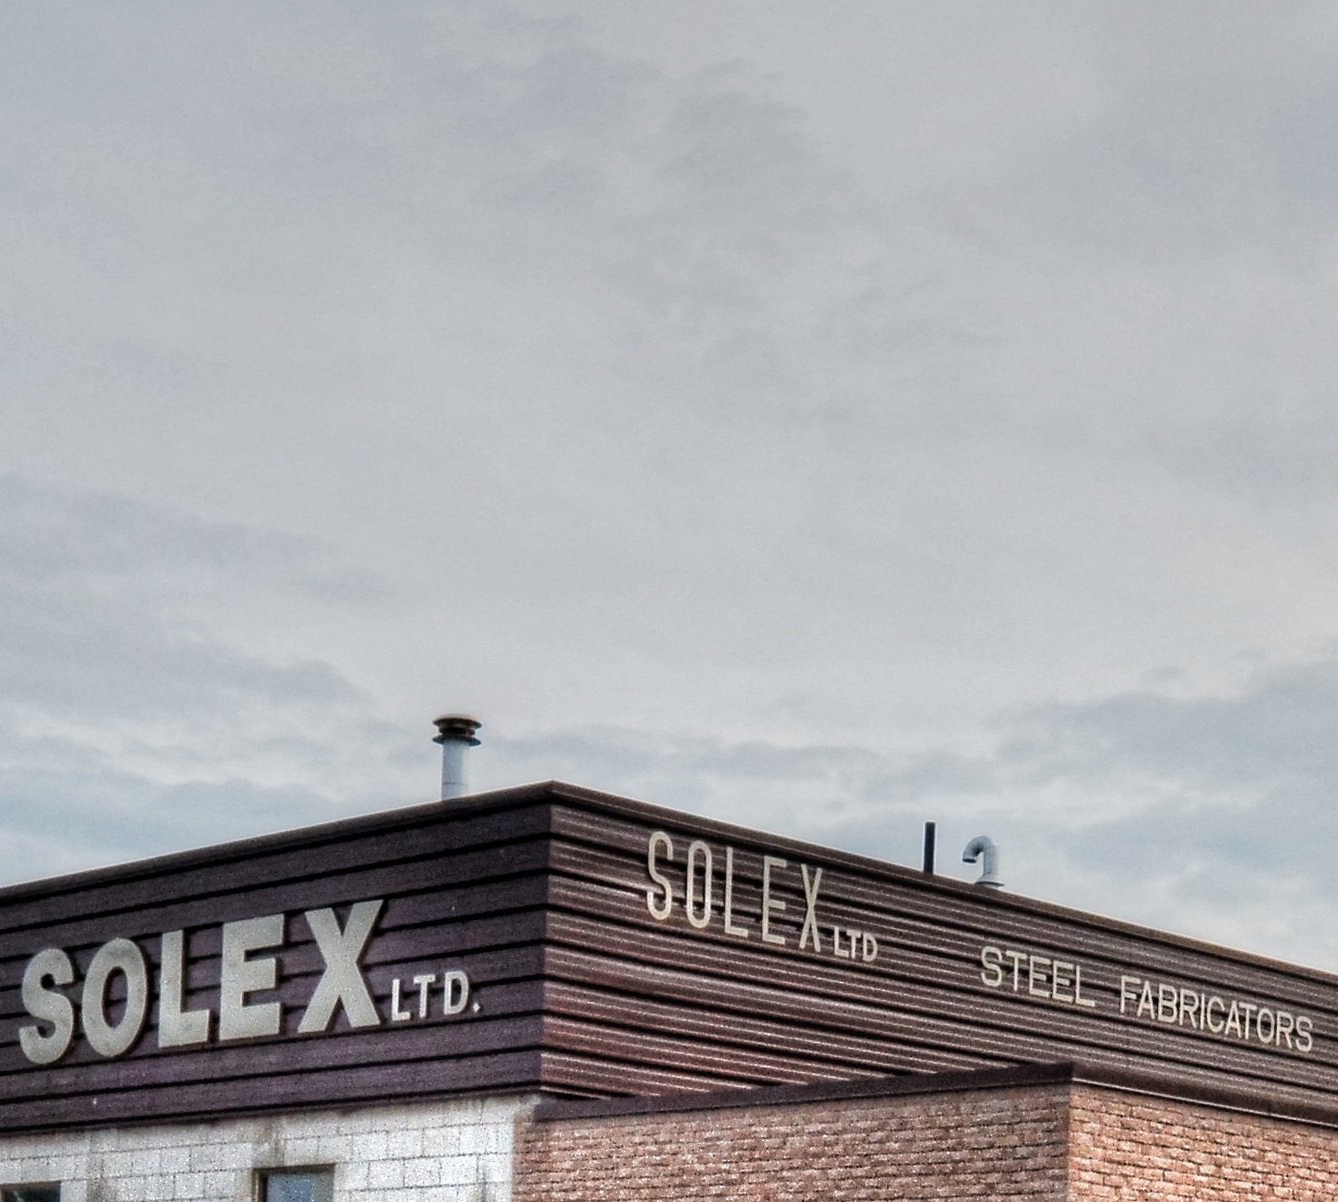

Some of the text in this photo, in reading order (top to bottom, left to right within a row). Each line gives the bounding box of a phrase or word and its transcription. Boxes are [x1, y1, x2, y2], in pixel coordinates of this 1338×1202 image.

[647, 831, 879, 962] SOLEX LTD
[18, 900, 482, 1065] SOLEX LTD.
[979, 946, 1314, 1053] STEEL FABRICATORS
